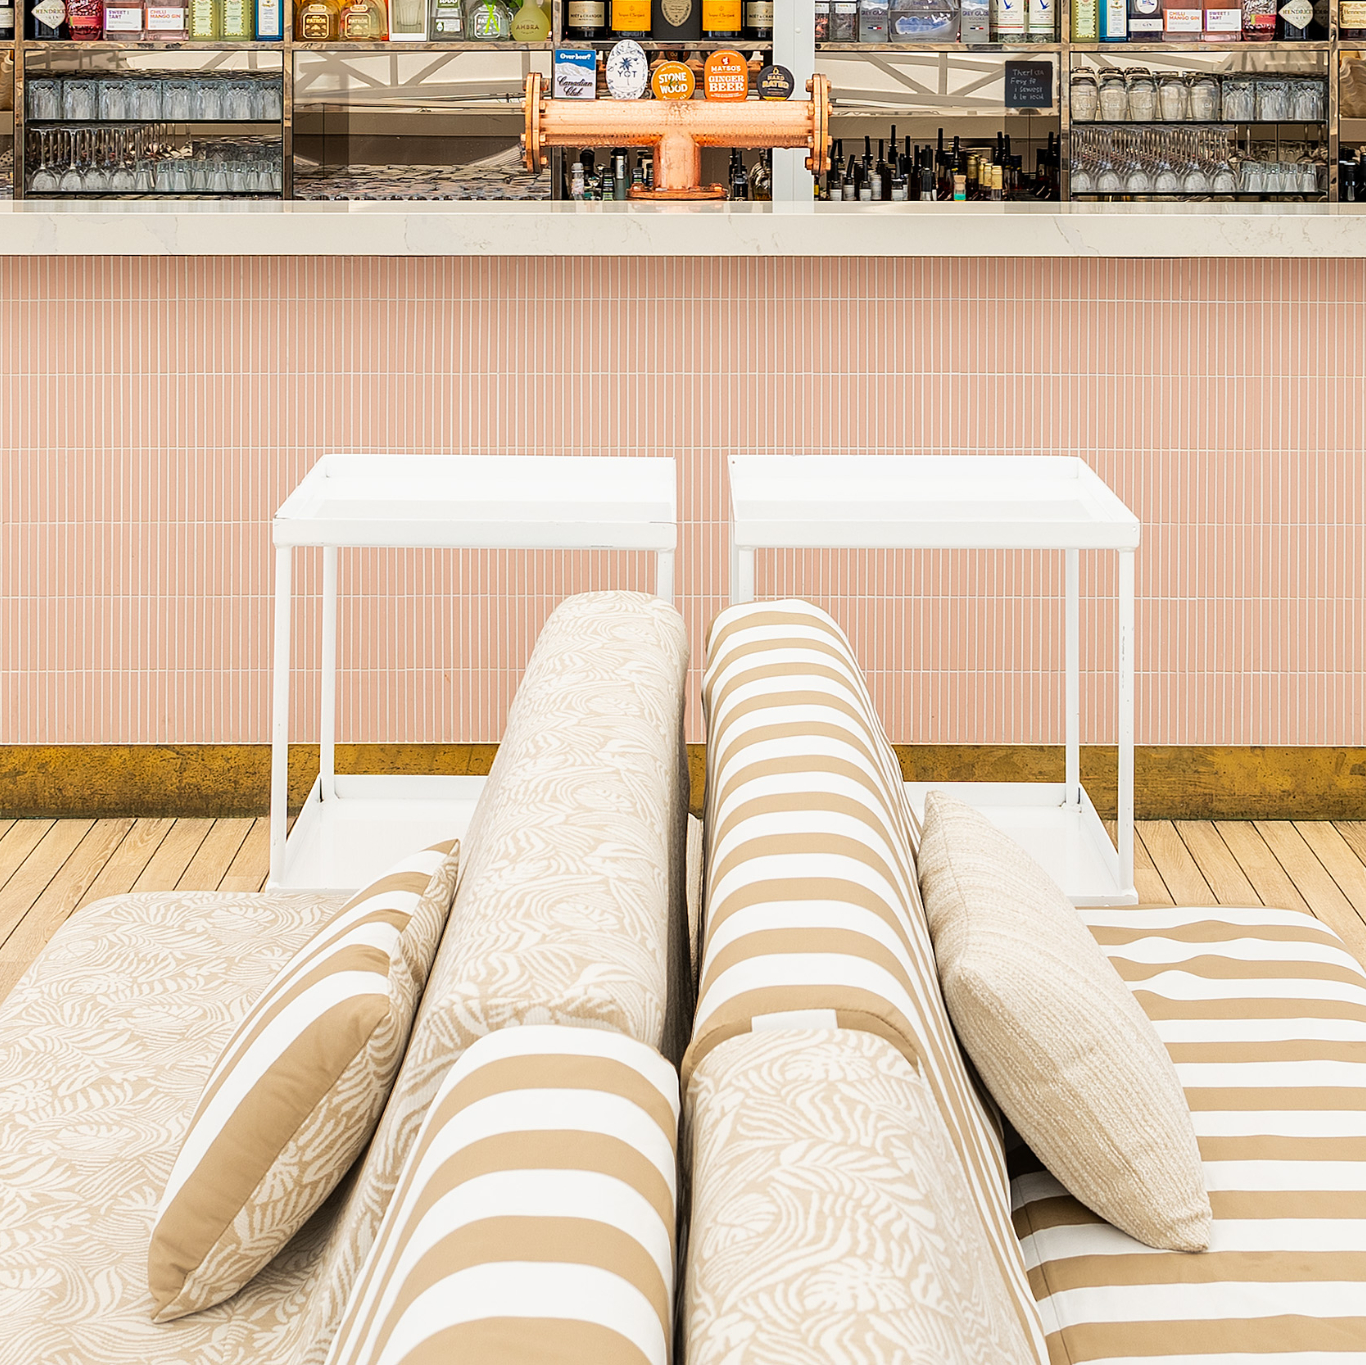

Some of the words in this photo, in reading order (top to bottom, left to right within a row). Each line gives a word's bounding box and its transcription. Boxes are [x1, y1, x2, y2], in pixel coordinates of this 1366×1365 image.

[559, 52, 575, 60] Over
[557, 75, 593, 87] Canadian
[658, 72, 687, 84] STONE
[708, 75, 745, 83] GINGER
[660, 84, 688, 94] WOOD
[709, 83, 745, 92] BEER
